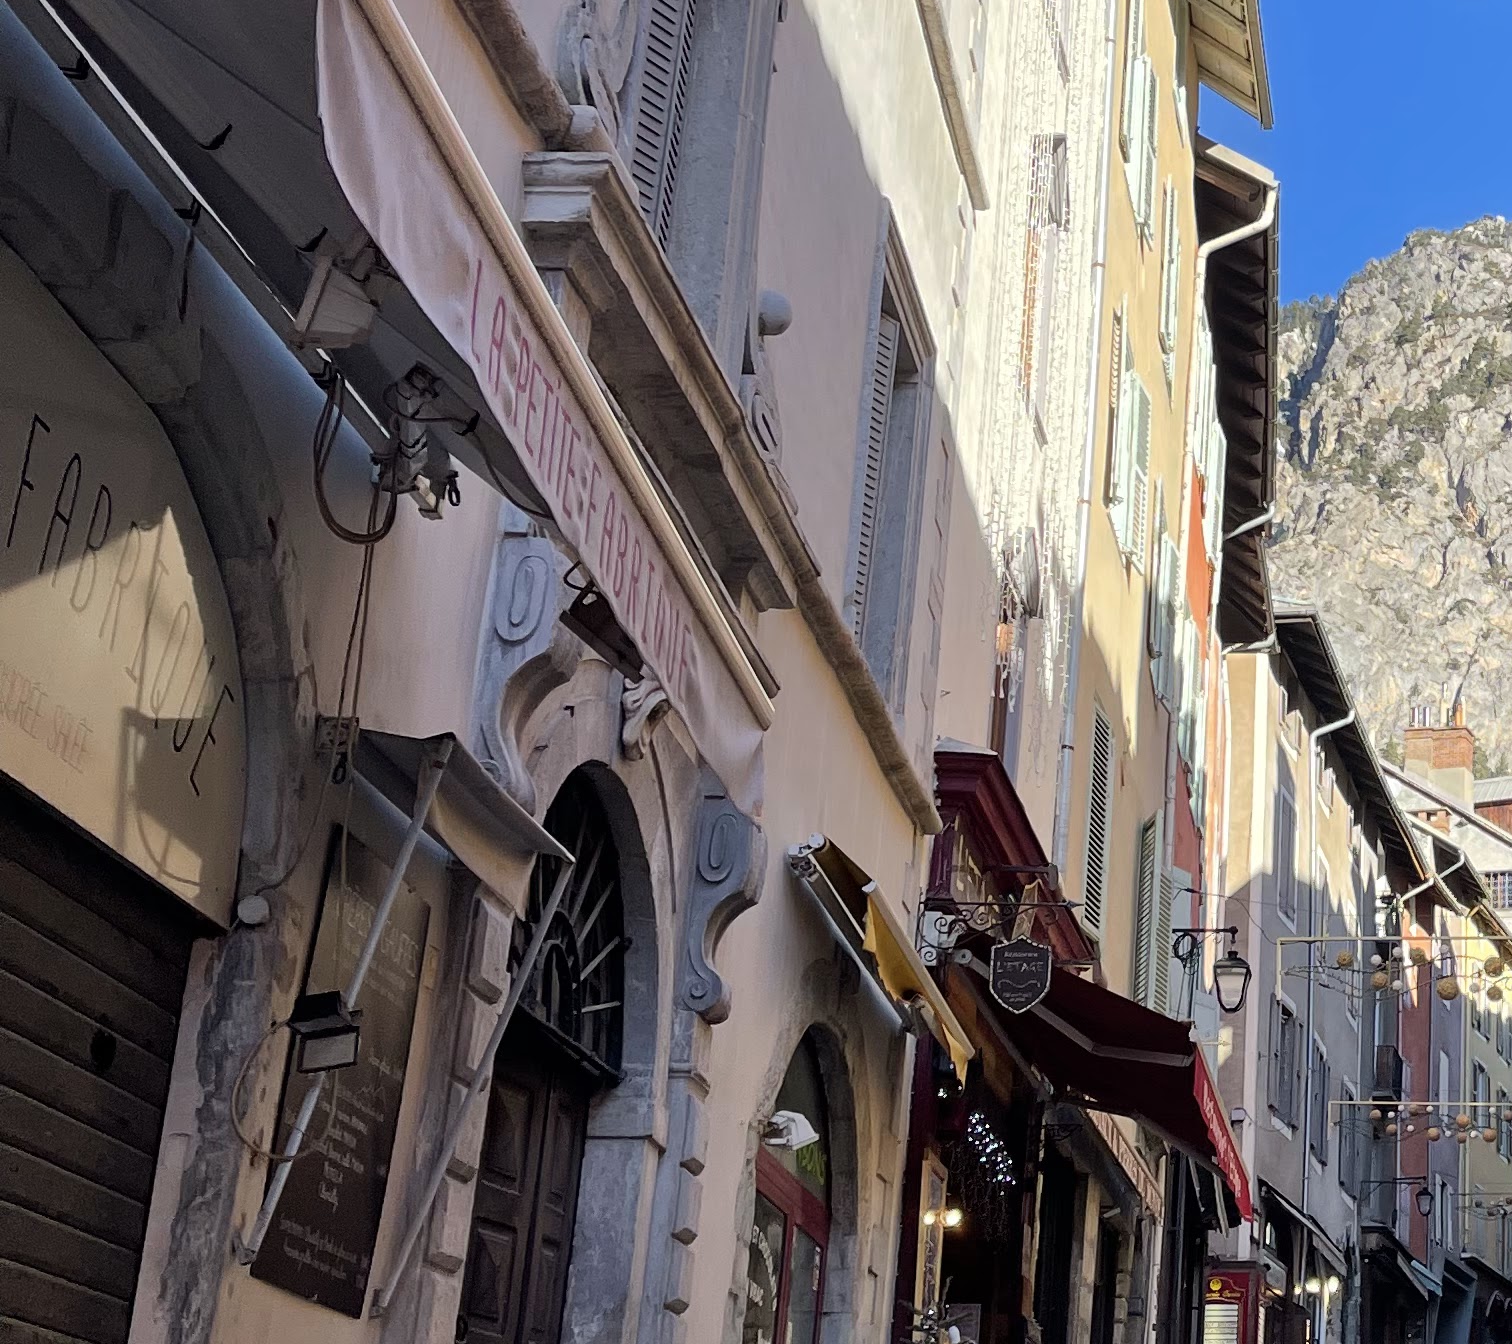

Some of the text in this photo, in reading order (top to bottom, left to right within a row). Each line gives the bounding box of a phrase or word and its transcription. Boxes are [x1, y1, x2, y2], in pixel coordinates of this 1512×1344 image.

[6, 413, 235, 797] FABRIQUE
[470, 258, 508, 396] LA
[584, 461, 693, 700] FABRIQUE
